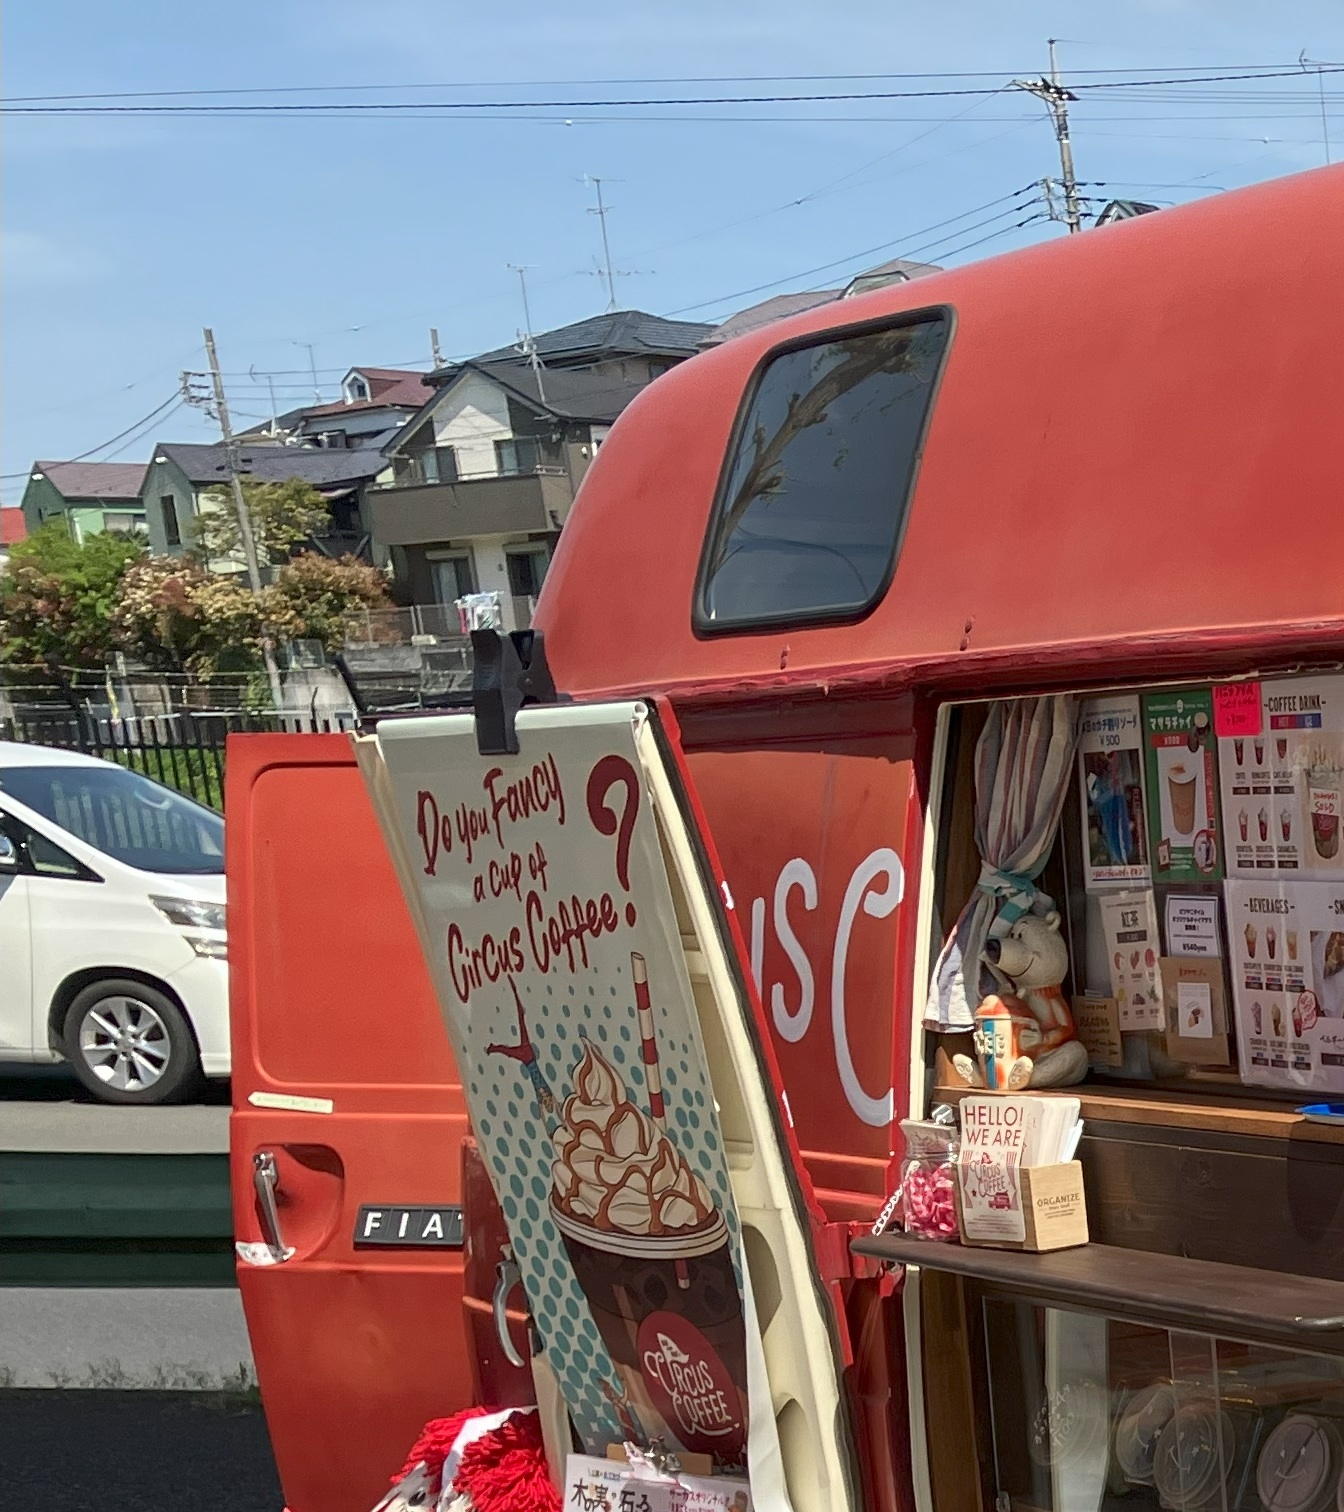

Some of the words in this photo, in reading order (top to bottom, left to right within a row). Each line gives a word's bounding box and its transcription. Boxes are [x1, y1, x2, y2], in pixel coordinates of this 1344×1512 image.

[417, 790, 451, 876] Do
[456, 803, 490, 864] you
[483, 752, 565, 849] Fancy
[474, 874, 486, 903] a
[489, 852, 522, 902] cup
[529, 841, 548, 892] of
[448, 922, 524, 1004] Circus
[964, 1105, 1024, 1127] HELLO!
[965, 1128, 989, 1146] WE
[992, 1129, 1022, 1147] ARE
[1037, 1193, 1080, 1207] ORGANIZE
[363, 1212, 463, 1239] FIA
